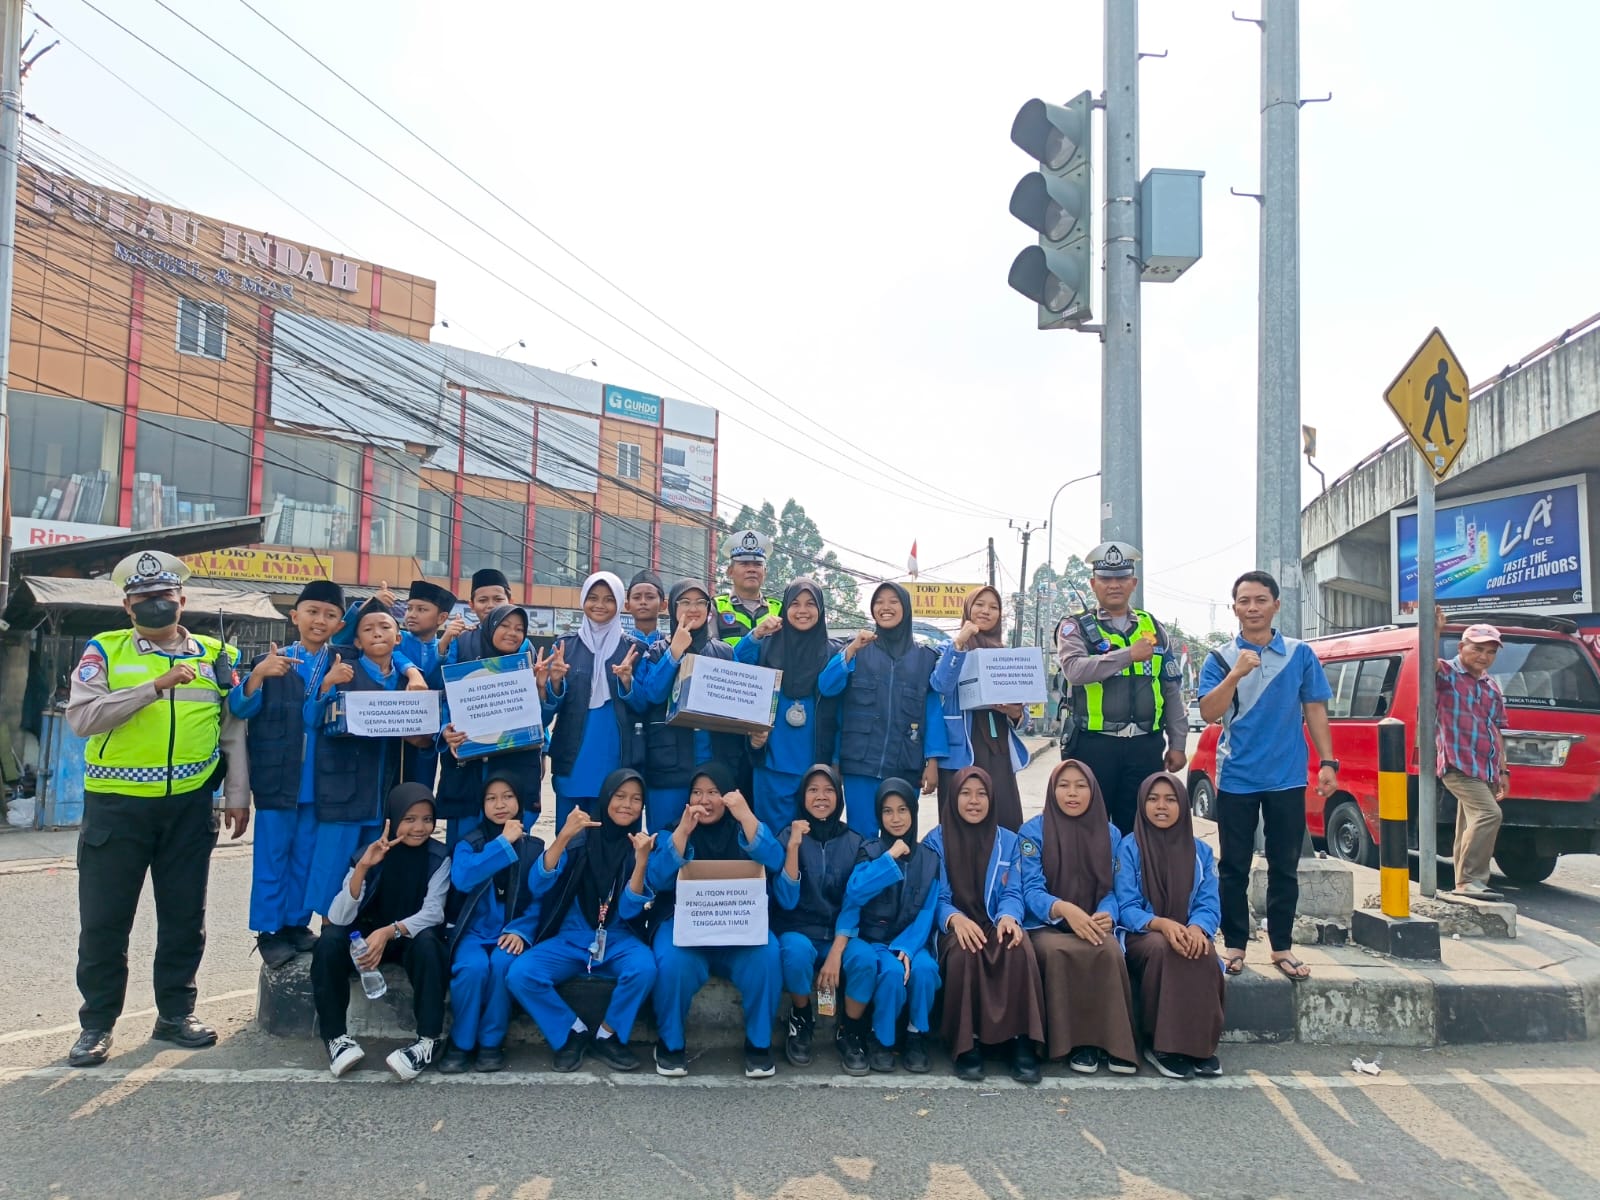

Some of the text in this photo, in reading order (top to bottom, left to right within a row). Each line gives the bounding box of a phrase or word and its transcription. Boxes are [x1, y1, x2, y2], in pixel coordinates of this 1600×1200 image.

[220, 227, 361, 293] INDAH
[624, 399, 657, 415] GUHDO
[1533, 536, 1554, 546] ICE
[211, 548, 302, 562] TOKO MAS
[1503, 550, 1548, 573] TASTE THE
[263, 561, 329, 576] INDAH
[1486, 556, 1578, 590] COOLEST FLAVORS
[916, 585, 940, 593] TOKO
[914, 595, 964, 608] LAU IND
[460, 687, 527, 703] PENGGALANGAN DANA
[467, 703, 488, 711] GEMPA
[469, 709, 502, 719] TENGGARA
